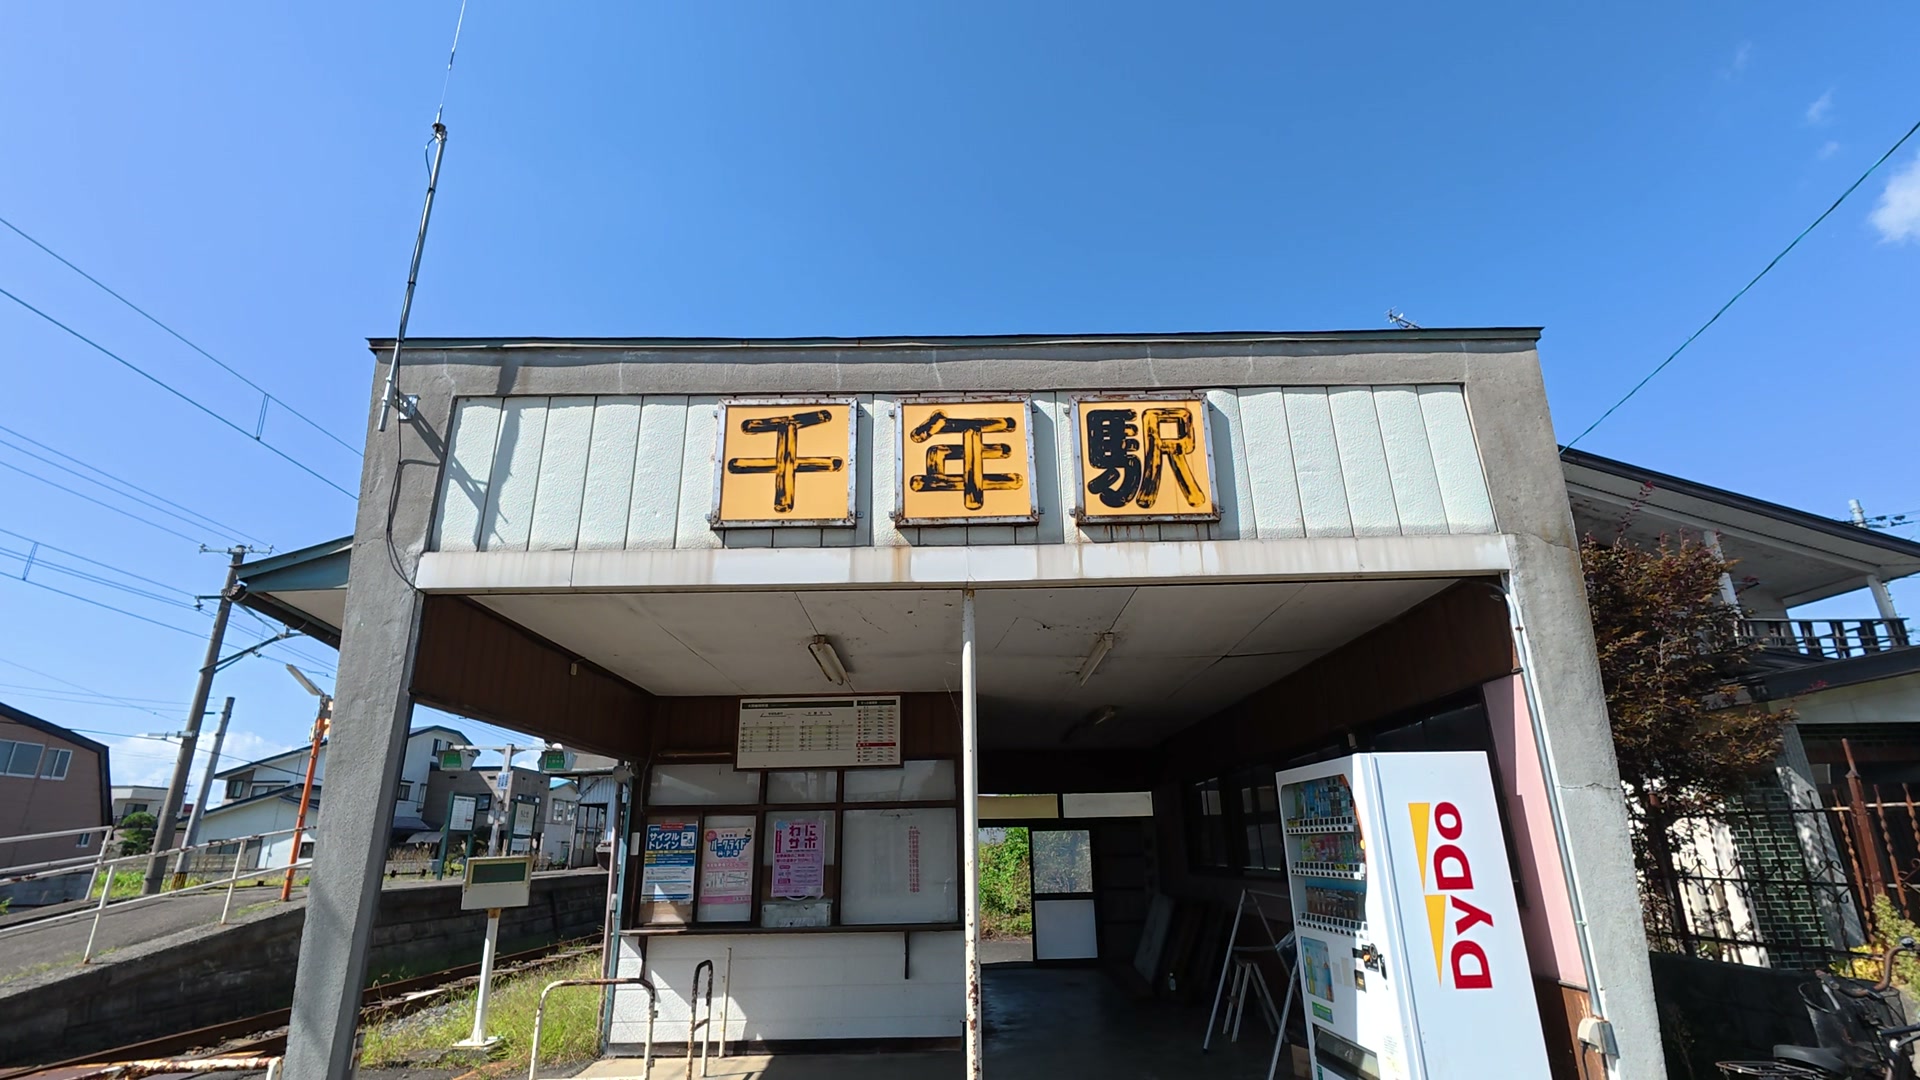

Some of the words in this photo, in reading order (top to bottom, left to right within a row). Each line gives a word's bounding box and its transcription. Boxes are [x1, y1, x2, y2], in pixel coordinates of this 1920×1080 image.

[727, 408, 1206, 513] 千年駅
[789, 825, 816, 836] わに
[649, 832, 680, 841] サイクル
[648, 841, 679, 850] トレイン
[789, 837, 818, 849] サポ
[1433, 802, 1494, 989] DyDo
